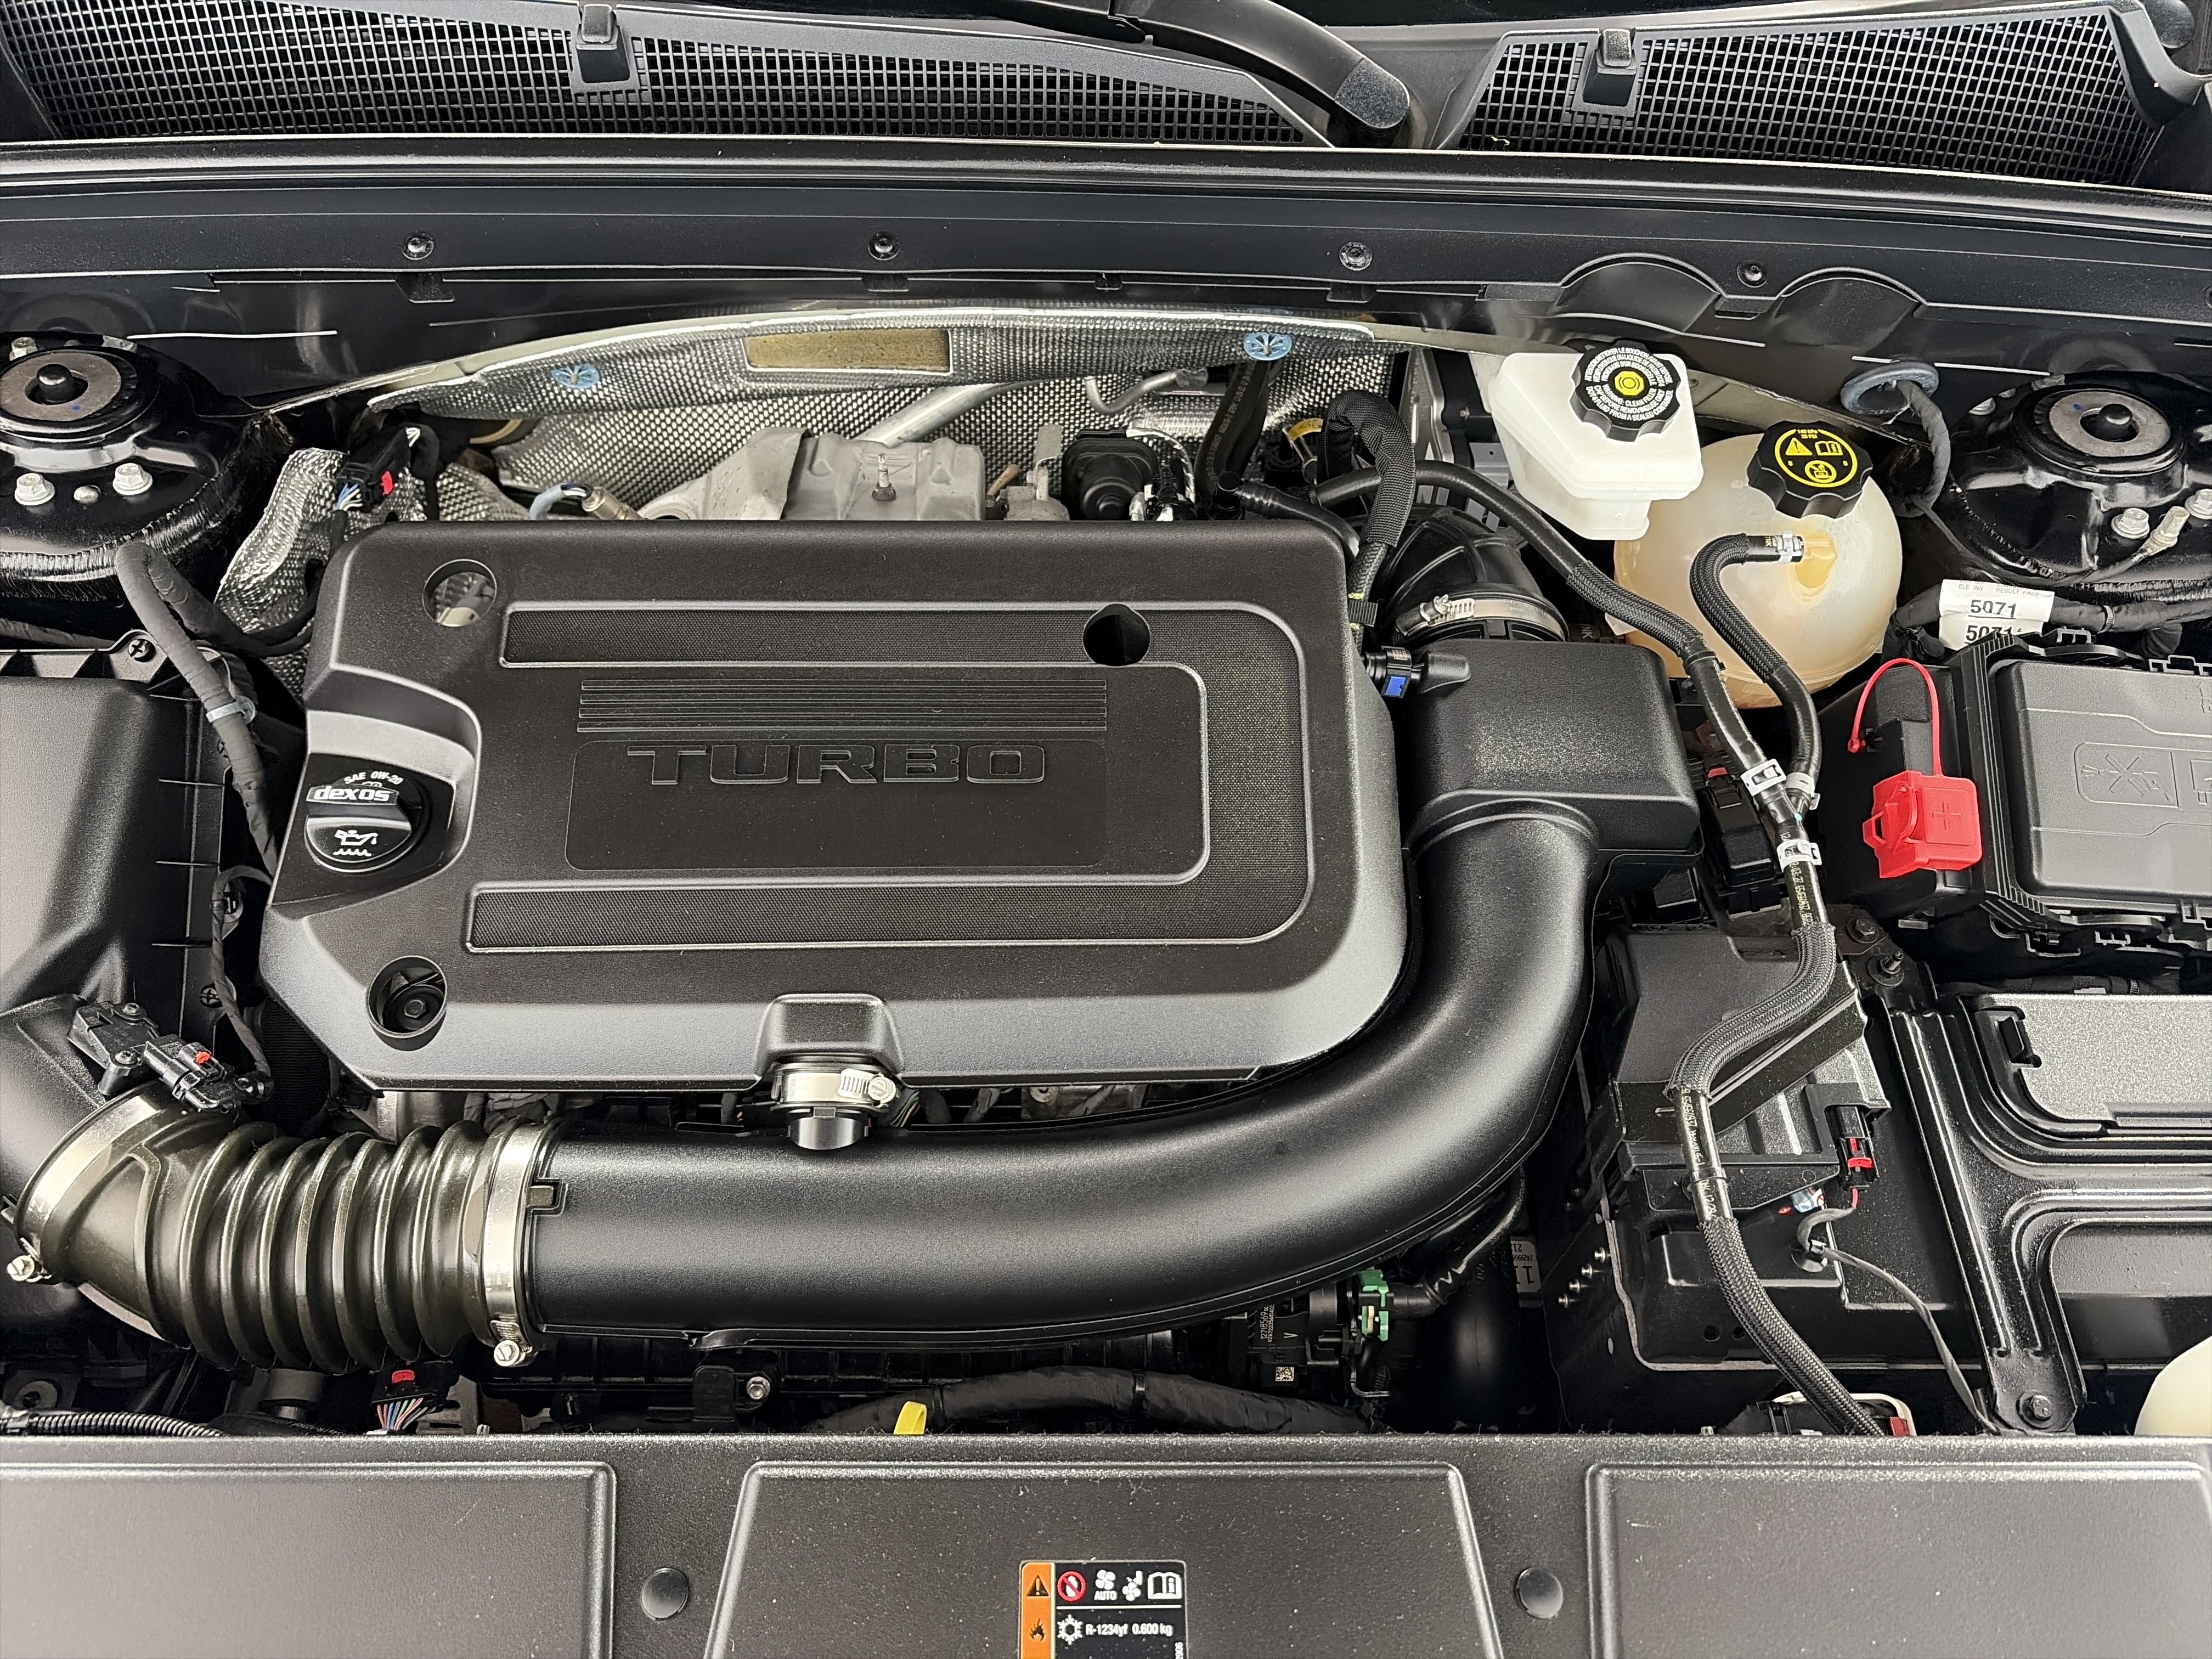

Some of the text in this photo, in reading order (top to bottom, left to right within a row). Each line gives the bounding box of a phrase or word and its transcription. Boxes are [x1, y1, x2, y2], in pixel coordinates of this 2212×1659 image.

[1626, 347, 1649, 359] BOUCHON
[1647, 356, 1664, 368] AVANT
[1594, 385, 1604, 396] CAP
[1600, 394, 1621, 410] BEFORE
[1602, 384, 1624, 405] WARNING:
[1643, 388, 1657, 403] FILLER
[1594, 399, 1610, 412] FLUID
[1609, 409, 1627, 420] FROM
[1632, 411, 1655, 421] SEALED
[1652, 390, 1673, 415] CONTAINER
[1971, 599, 2017, 619] 5071
[628, 744, 1045, 786] TURBO
[345, 770, 404, 785] SAE 0W-20
[313, 785, 391, 802] dexos
[1790, 861, 1804, 884] 2:03:27
[1260, 1311, 1269, 1340] 12718569
[1094, 1590, 1117, 1600] AUTO
[1085, 1623, 1173, 1637] R-1234yf 0.600 kg
